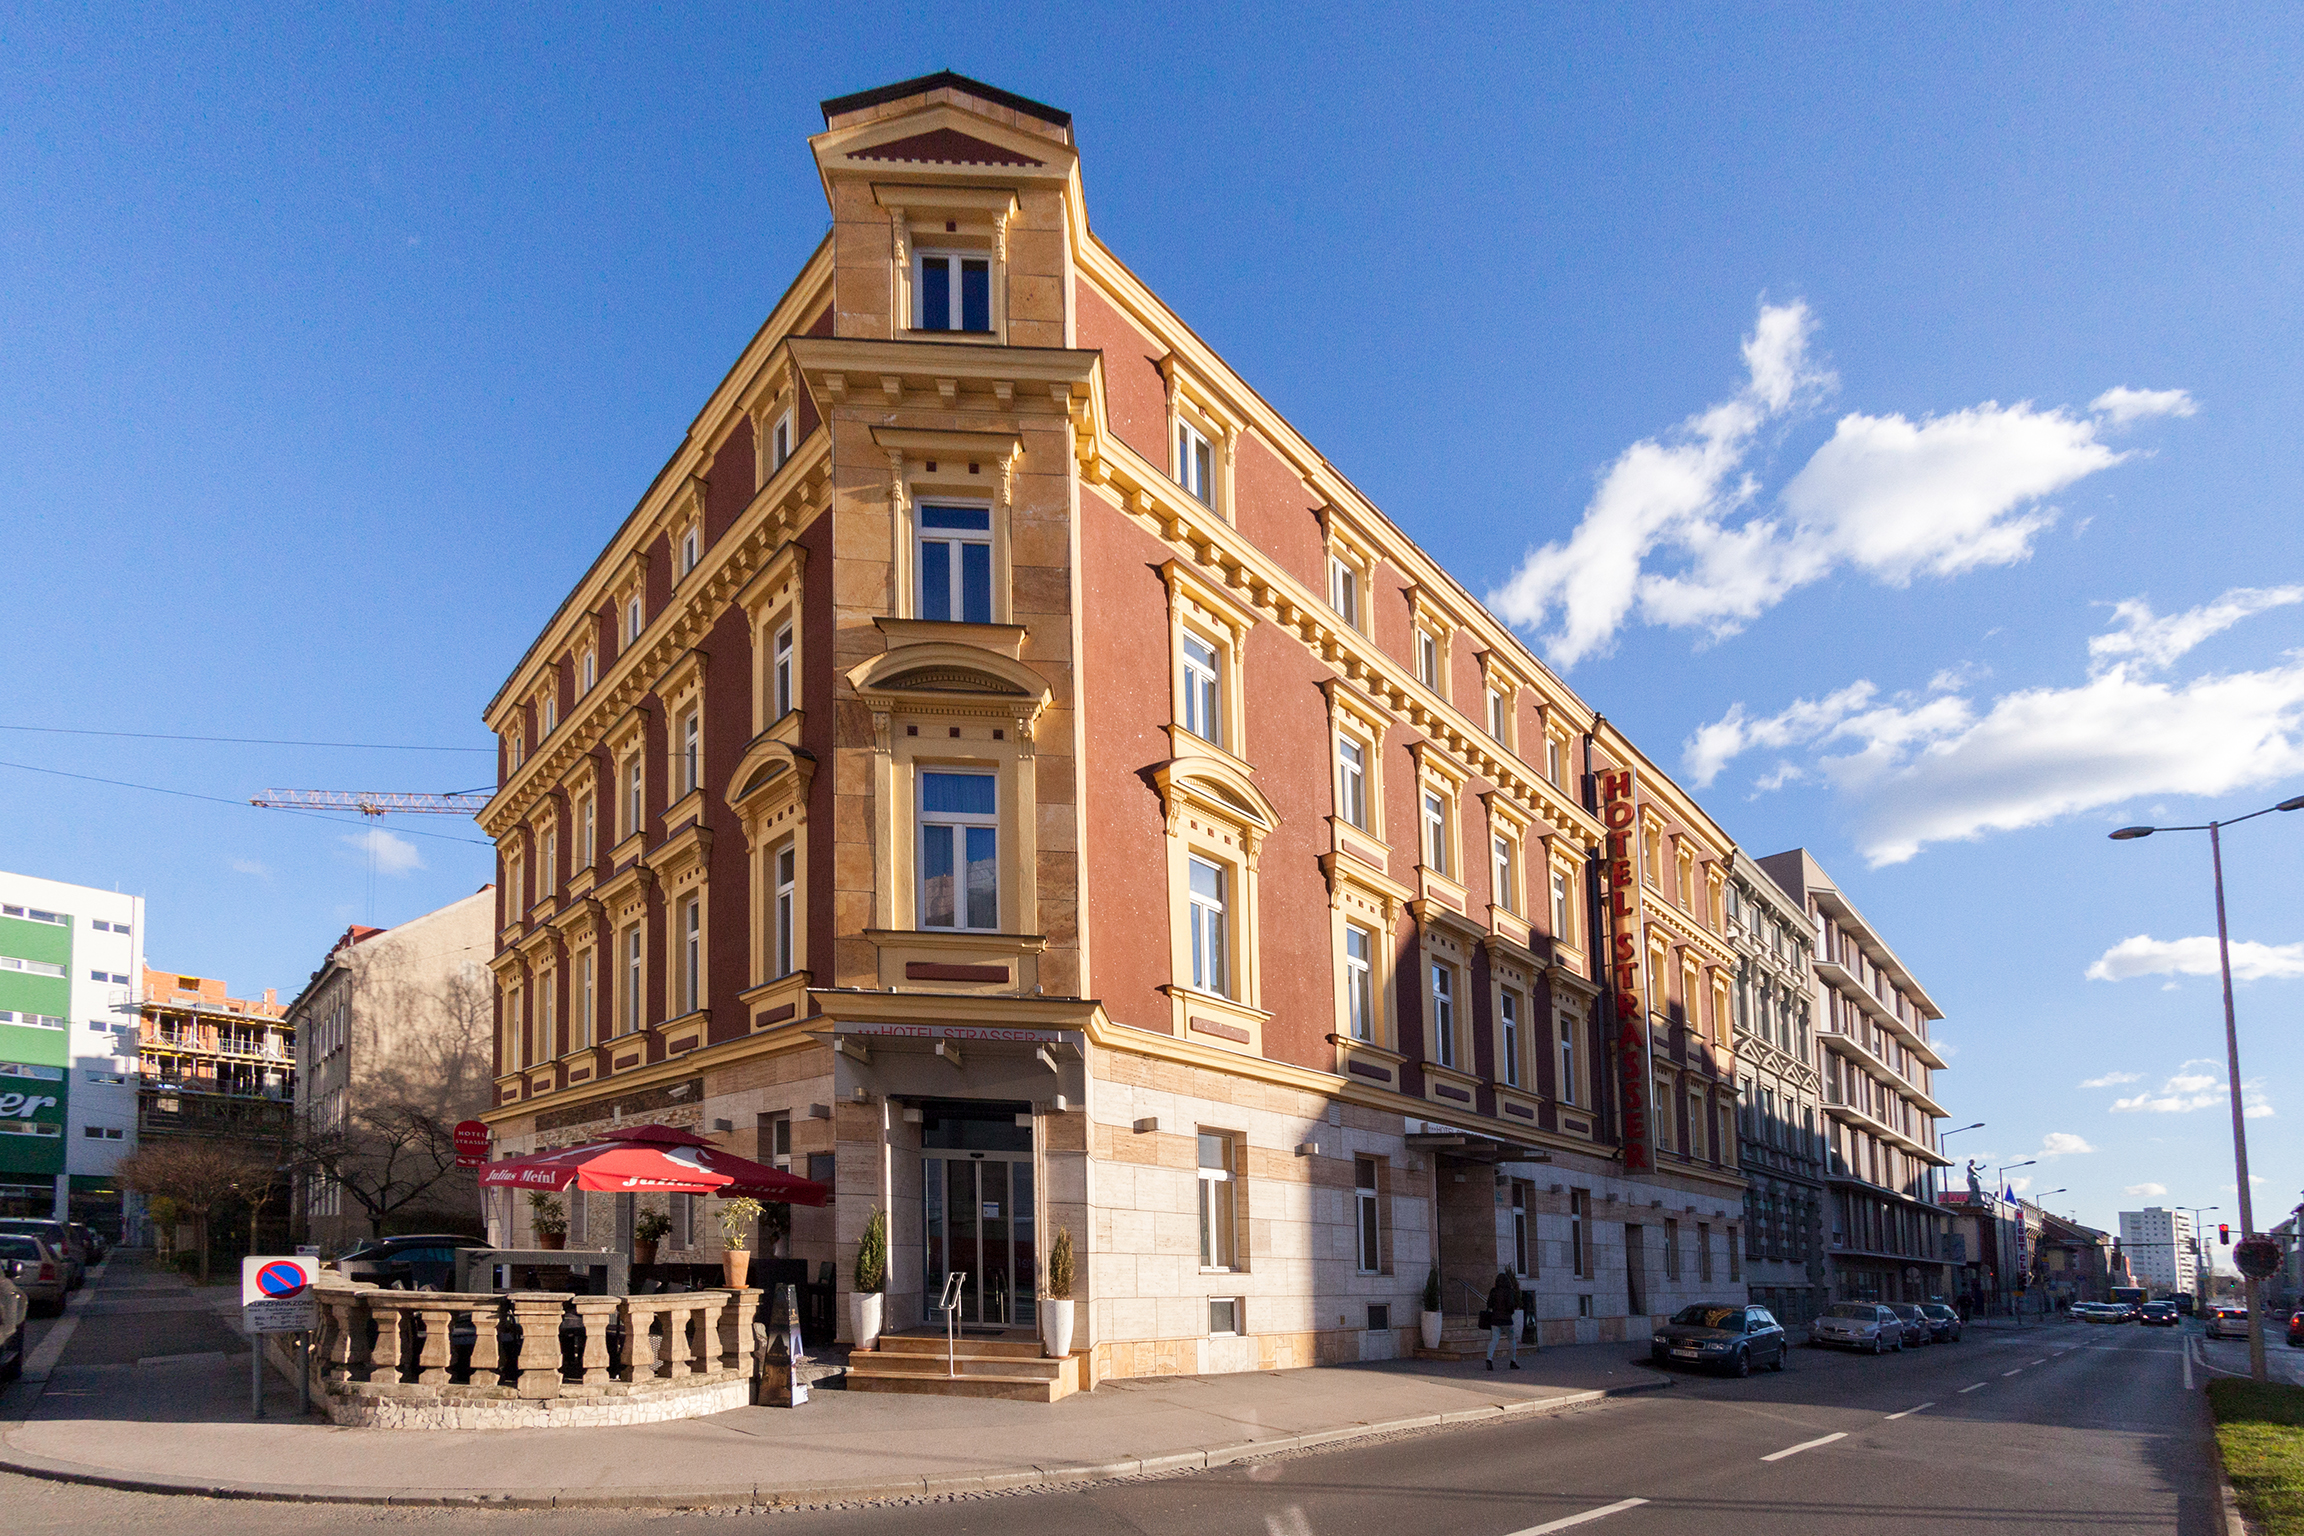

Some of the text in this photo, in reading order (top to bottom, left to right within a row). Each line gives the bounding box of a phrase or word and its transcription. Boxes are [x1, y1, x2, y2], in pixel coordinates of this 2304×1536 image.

[1605, 770, 1648, 1169] HOTEL STRASSER
[944, 1028, 1036, 1041] STRASSER
[458, 1130, 486, 1138] HOTEL
[485, 1169, 556, 1184] Julius Meinl
[2016, 1212, 2026, 1251] NIGHT
